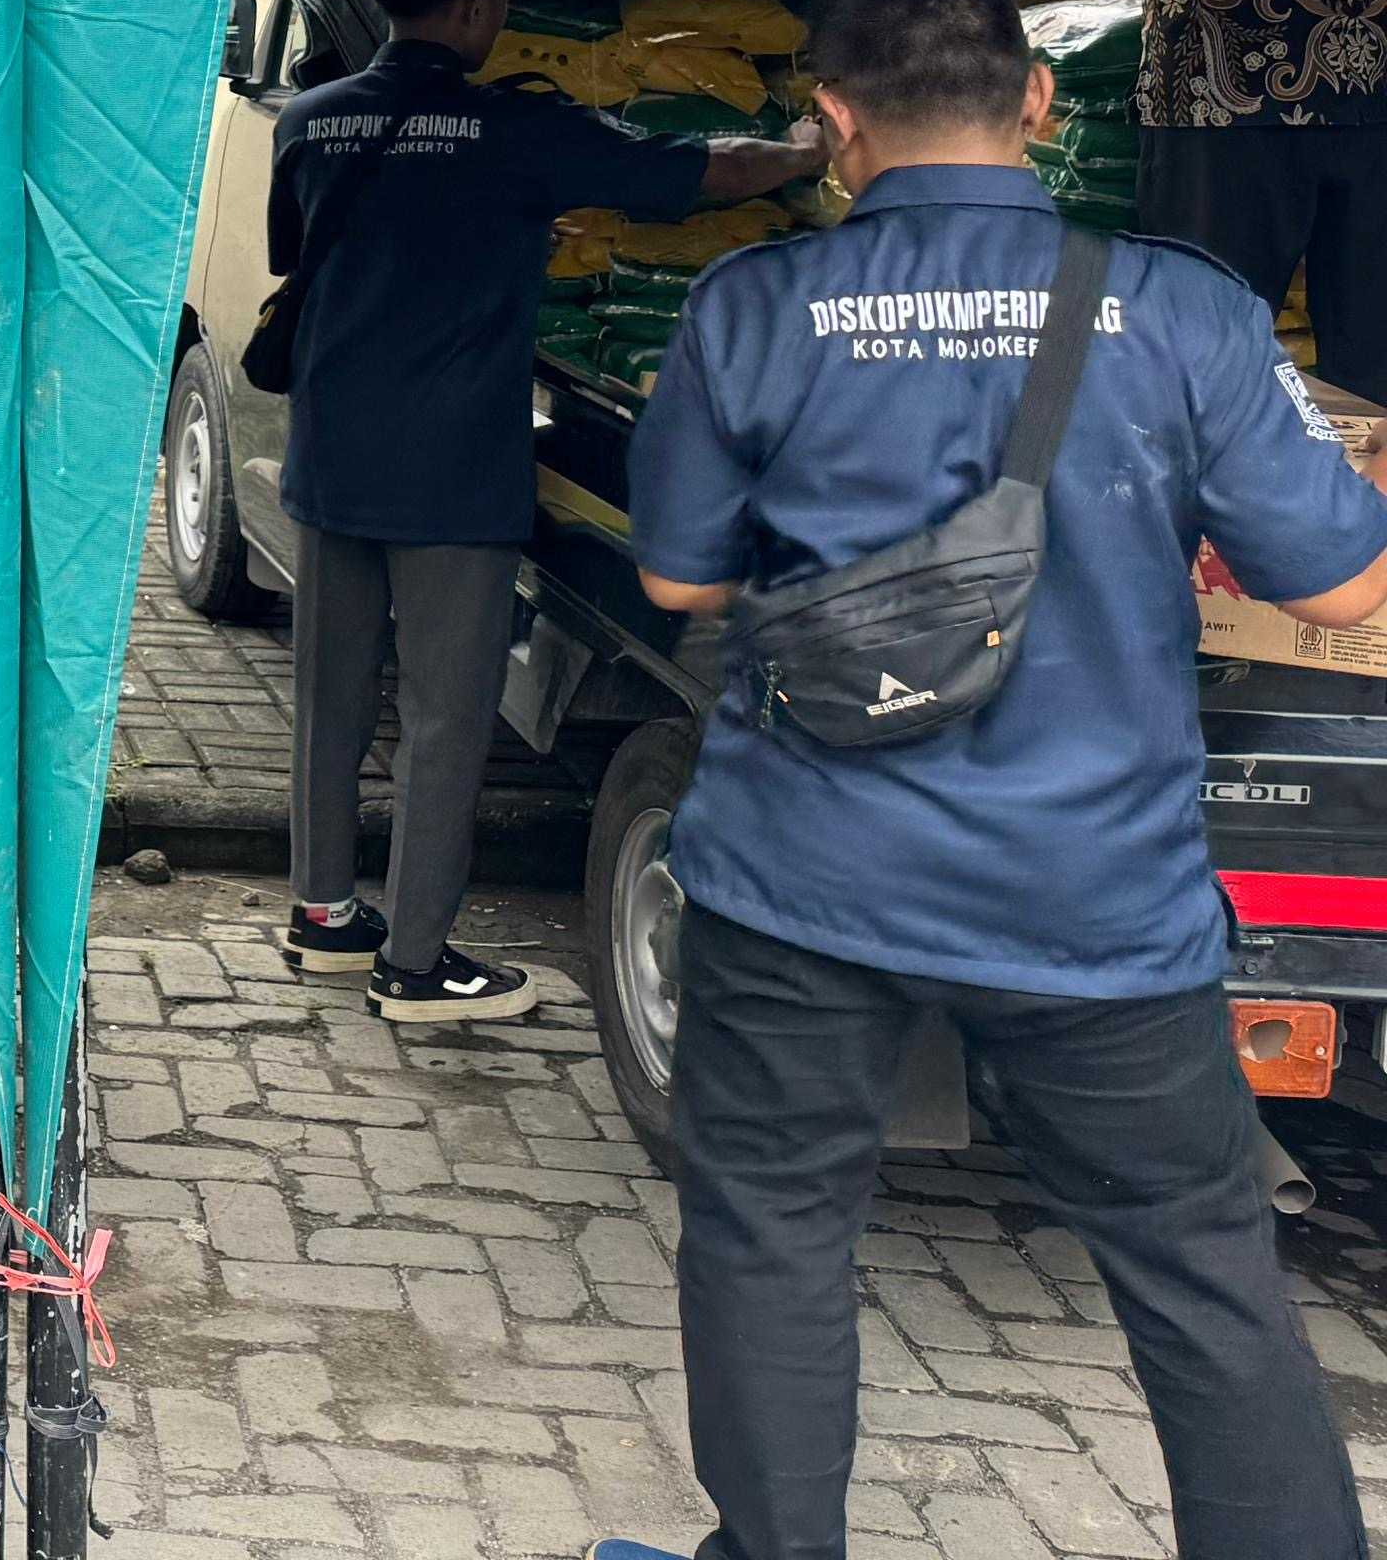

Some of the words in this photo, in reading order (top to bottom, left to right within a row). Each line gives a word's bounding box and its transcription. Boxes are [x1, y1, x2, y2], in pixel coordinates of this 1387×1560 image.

[306, 114, 482, 141] DISKOPUKERINDAG
[323, 142, 361, 155] KOTA
[377, 141, 455, 156] JOKERTO
[852, 338, 924, 360] KOTA
[1204, 621, 1236, 633] AWIT
[865, 690, 939, 717] EIGER
[1245, 785, 1309, 803] DLI
